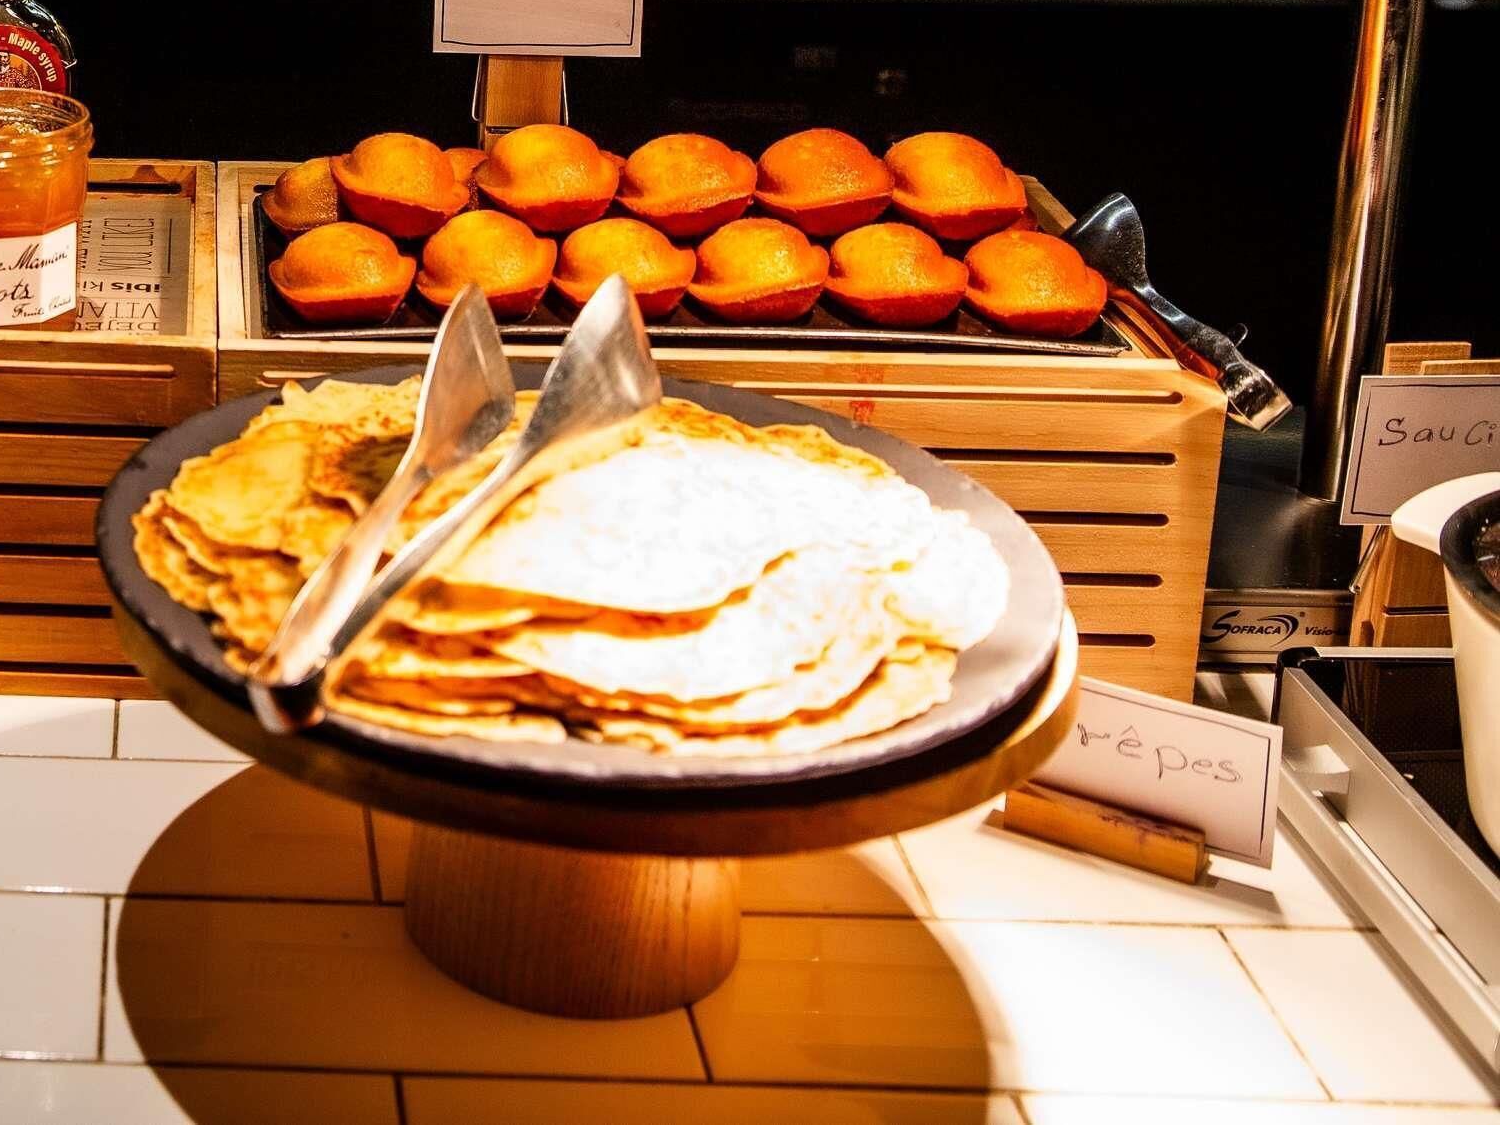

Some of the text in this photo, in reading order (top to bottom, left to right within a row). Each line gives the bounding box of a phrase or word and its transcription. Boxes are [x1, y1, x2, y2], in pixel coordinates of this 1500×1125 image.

[7, 32, 41, 56] Maple
[38, 52, 58, 83] syrup
[8, 243, 68, 271] Maman
[98, 251, 153, 271] YOU
[111, 281, 160, 294] ibis
[1202, 609, 1282, 644] SOFRACA
[1077, 723, 1243, 784] rêpes
